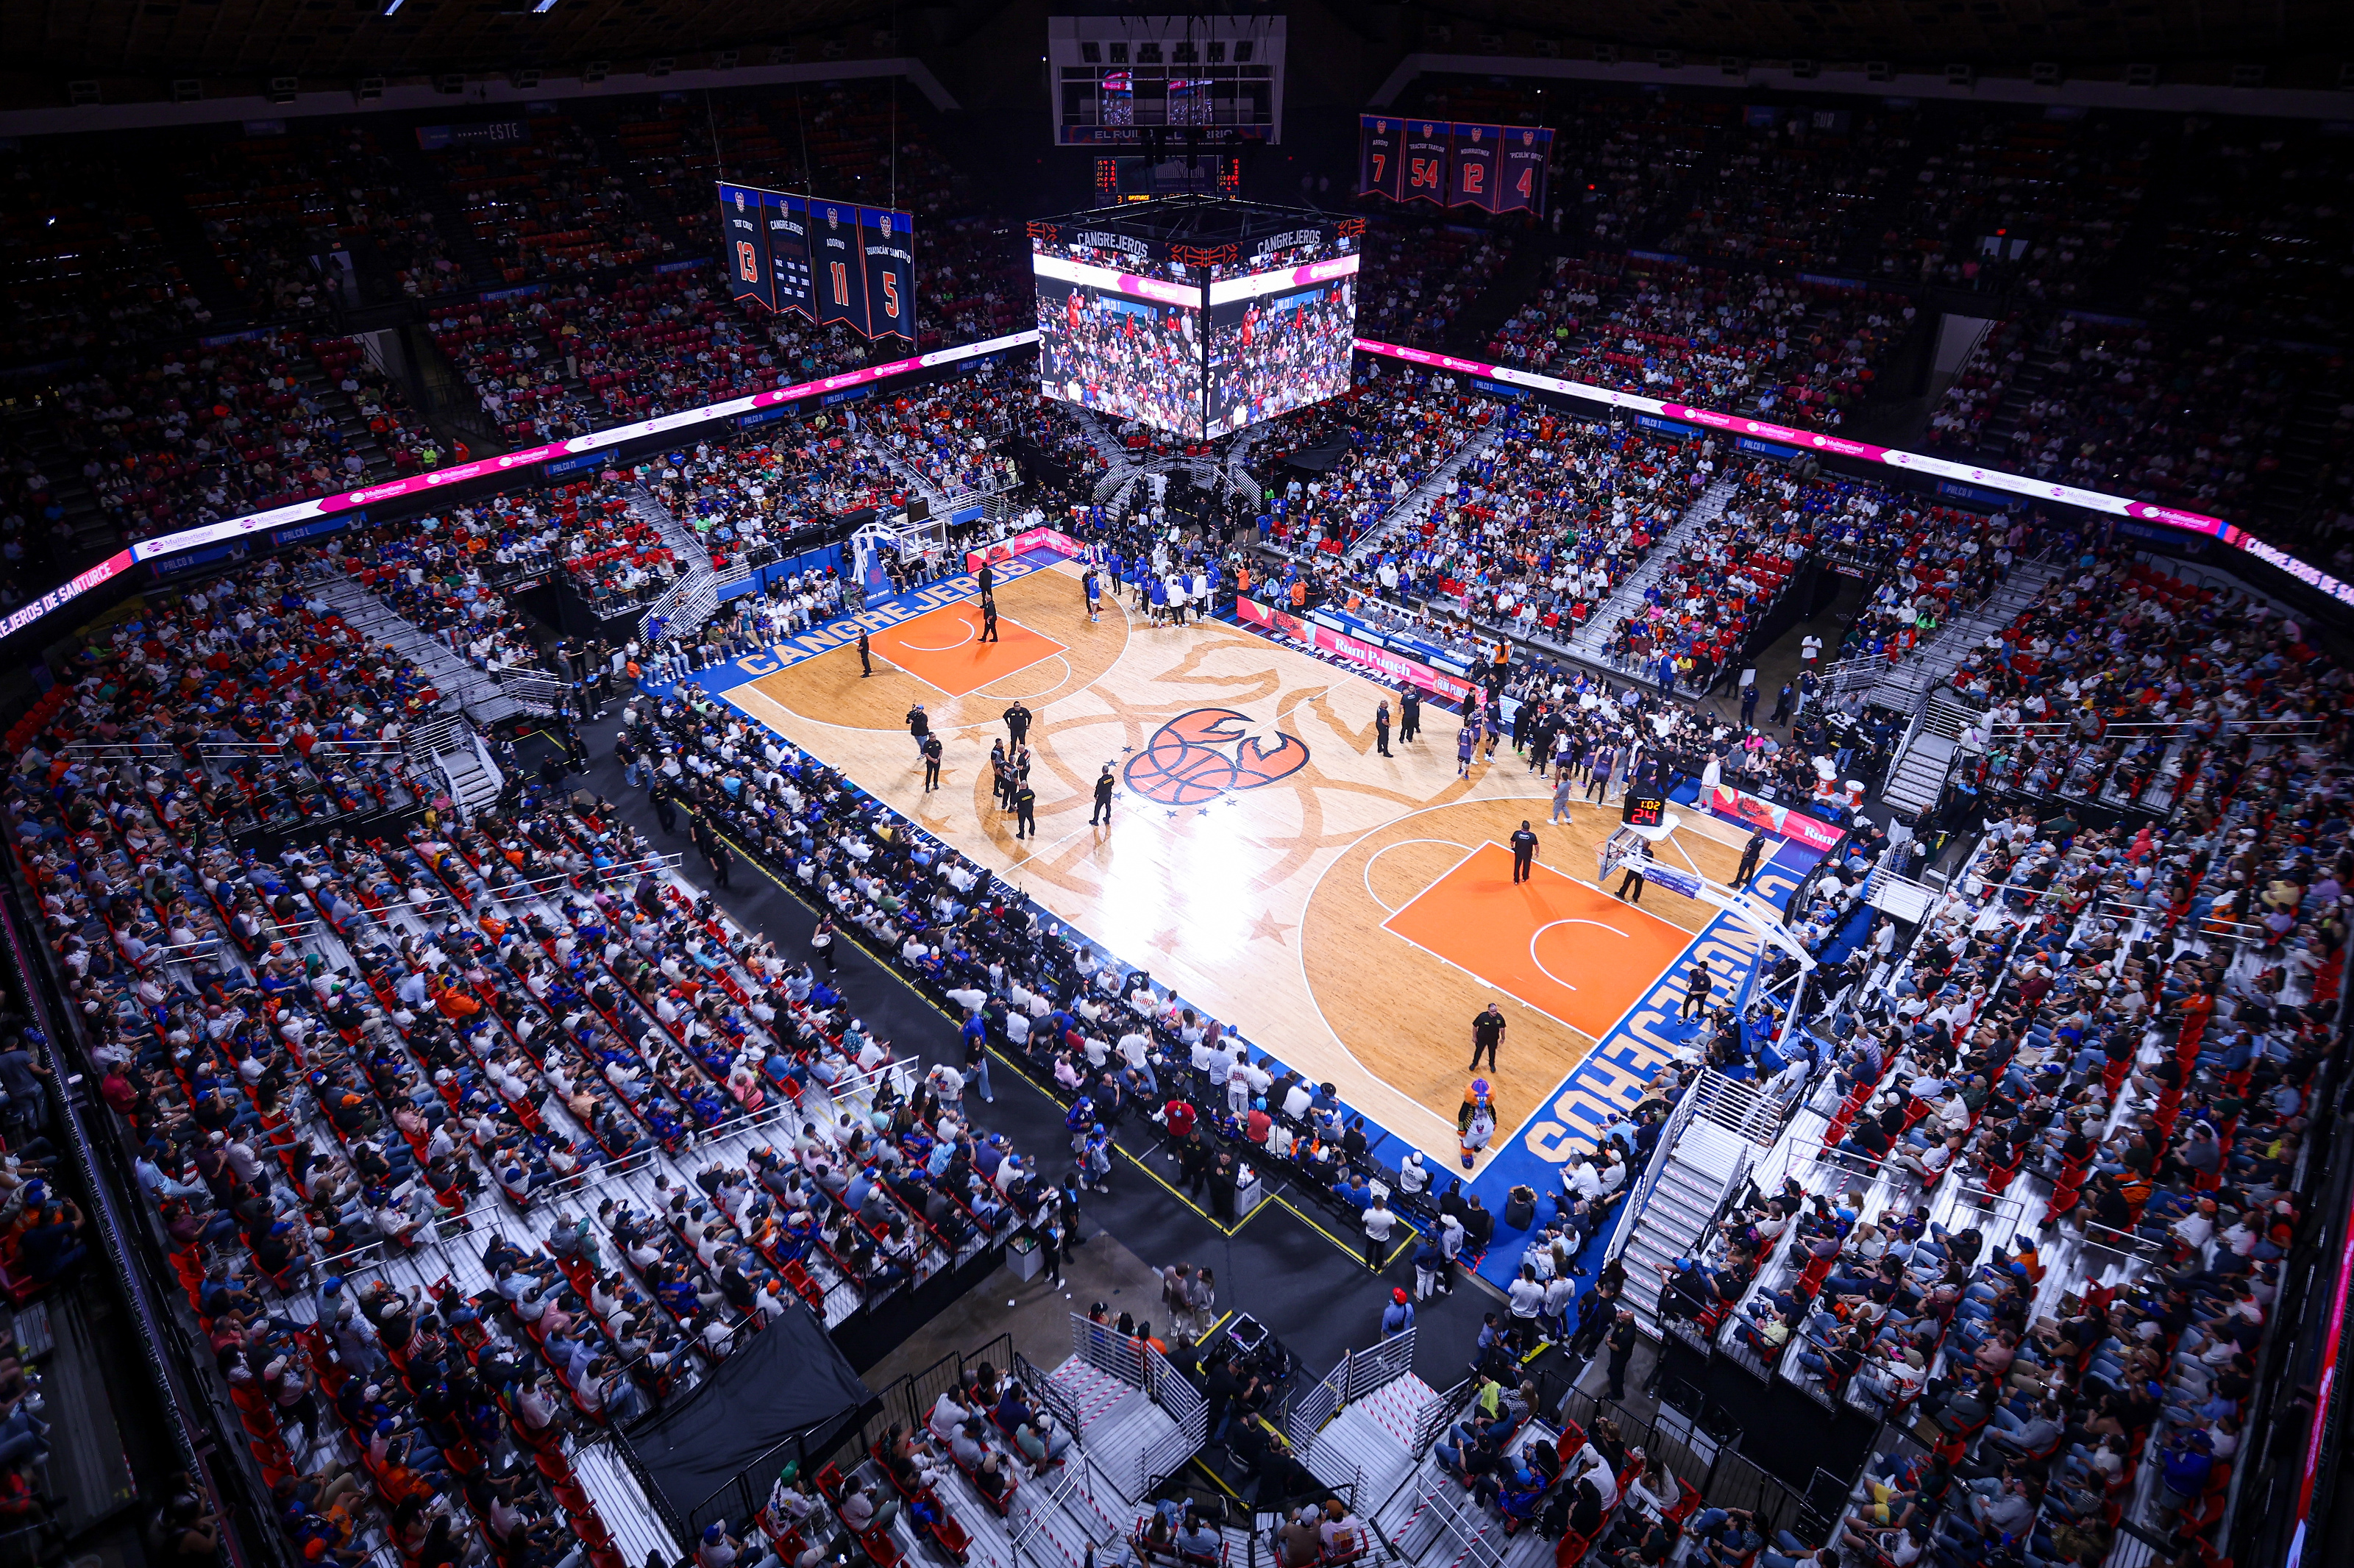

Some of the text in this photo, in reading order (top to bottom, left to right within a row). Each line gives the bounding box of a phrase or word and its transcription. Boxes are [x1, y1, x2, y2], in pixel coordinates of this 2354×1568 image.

[489, 123, 519, 140] ESTE
[1095, 130, 1111, 139] EL
[1372, 139, 1389, 147] ARROYO
[1373, 154, 1386, 182] 7
[1411, 157, 1438, 189] 54
[1463, 163, 1484, 193] 12
[1516, 167, 1533, 199] 4
[1117, 195, 1123, 204] 3
[769, 220, 804, 236] CANGREJEROS
[826, 238, 844, 250] ADORNO
[1077, 231, 1149, 257] CANGREJEROS
[1257, 229, 1321, 256] CANGREJEROS
[736, 240, 758, 283] 13
[830, 261, 850, 307] 11
[882, 271, 900, 318] 5
[962, 361, 973, 370] PALCO
[1476, 380, 1489, 391] PALCO
[827, 394, 840, 403] PALCO
[744, 415, 759, 424] PALCO
[1641, 416, 1663, 428] PALCO T
[1743, 440, 1766, 452] PALCO U
[1827, 439, 1864, 453] Multinational
[512, 449, 550, 462] Multinational
[552, 460, 576, 472] PALCO M
[1912, 457, 1952, 471] Multinational
[441, 466, 480, 478] Multinational
[1987, 473, 2029, 488] Multinational
[364, 482, 407, 498] Multinational
[1946, 485, 1967, 496] PALCO
[2066, 490, 2111, 505] Multinational
[257, 507, 302, 524] Multinational
[165, 529, 214, 546] Multinational
[282, 527, 310, 541] PALCO L
[1024, 532, 1062, 546] Rum Punch
[163, 555, 195, 571] PALCO K
[43, 592, 60, 612] DE
[59, 562, 113, 602] SANTURCE
[736, 560, 1032, 675] CANGREJEROS
[1279, 641, 1393, 688] CIUDAD CAPITAL
[1286, 635, 1403, 685] SAN JUAN
[1334, 638, 1411, 677] Rum Punch
[1437, 678, 1450, 691] RUM
[1640, 800, 1661, 810] 1:02
[1631, 808, 1657, 824] 24
